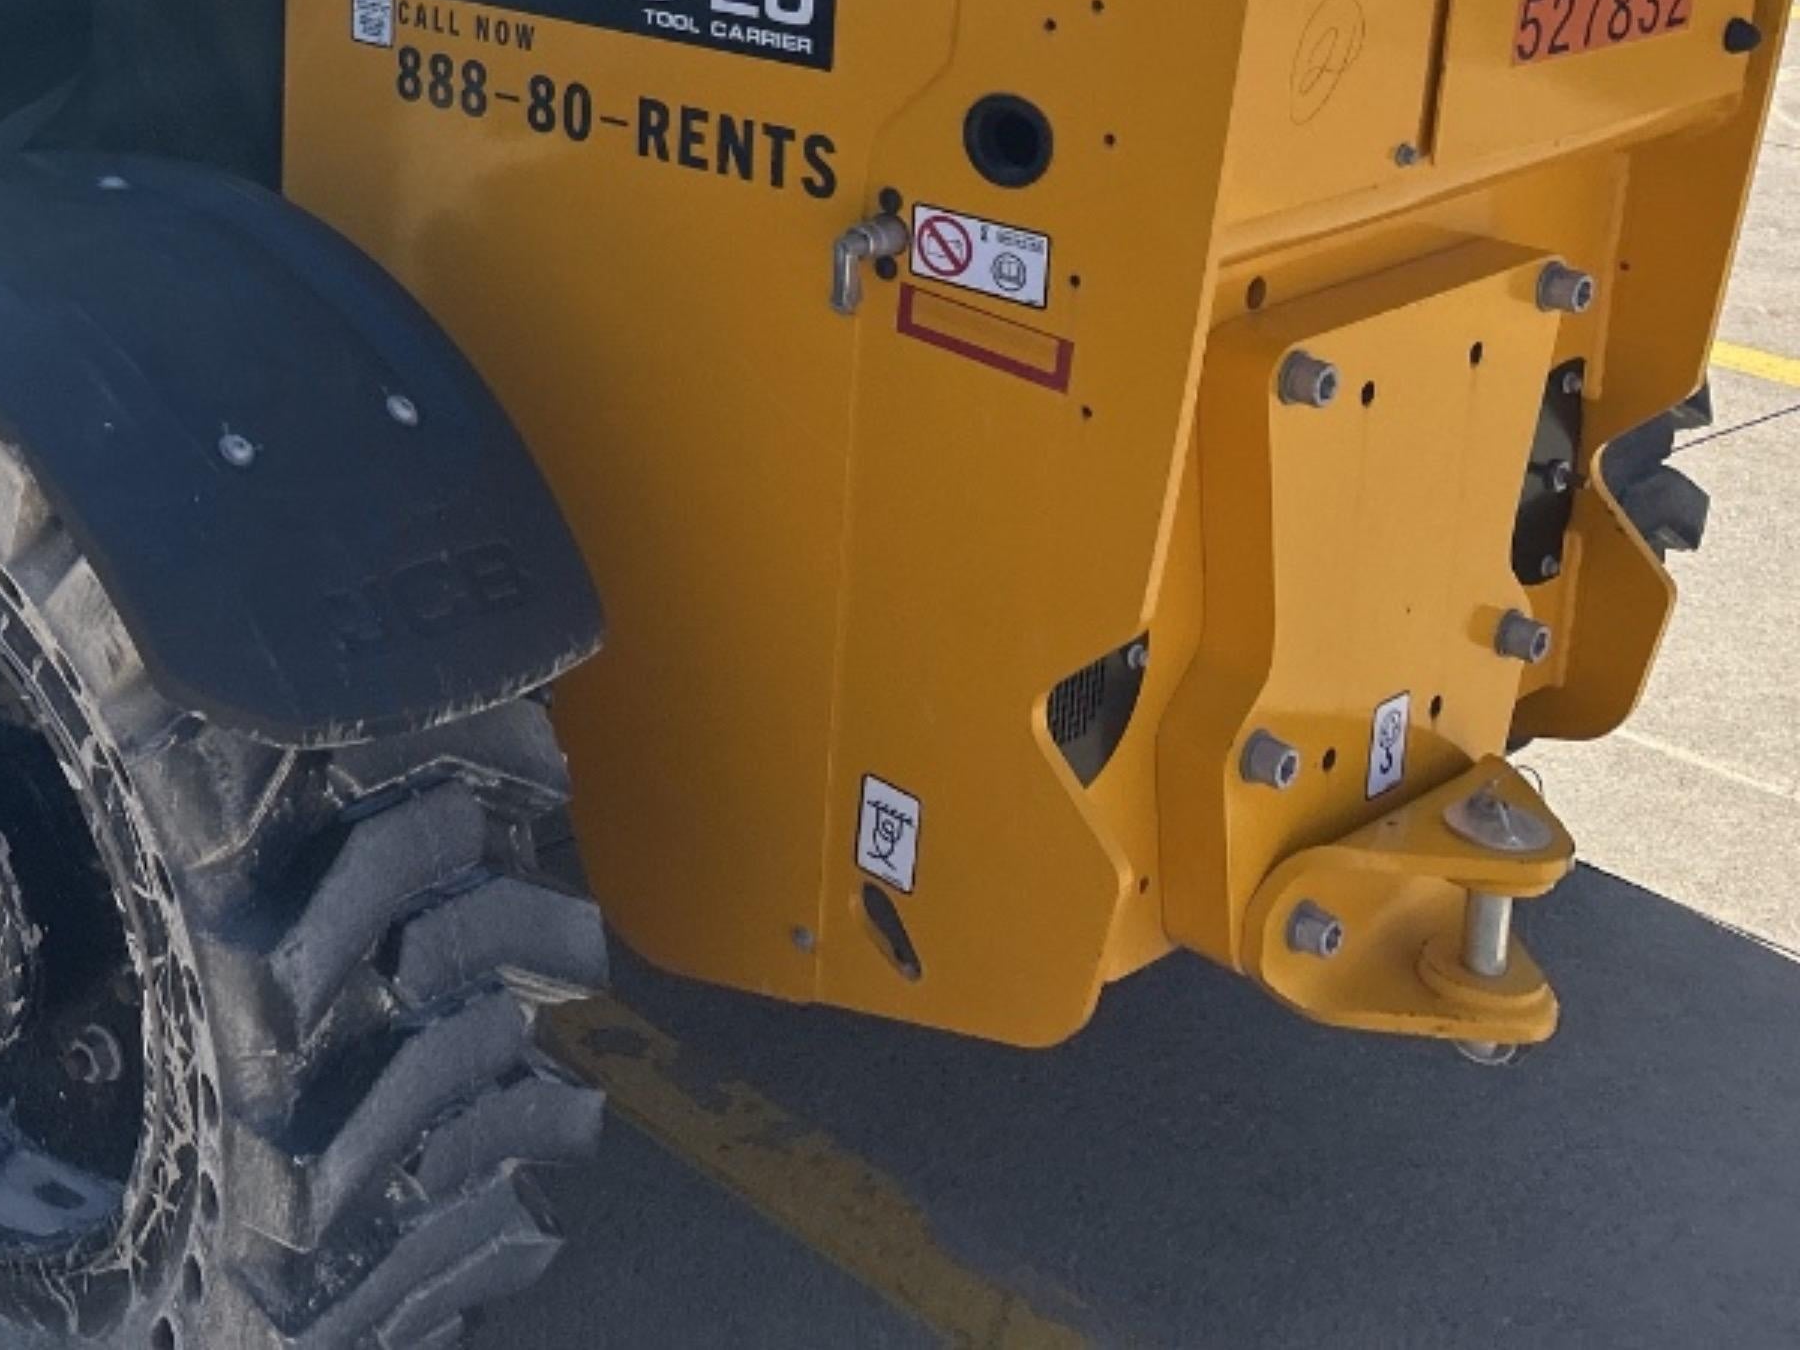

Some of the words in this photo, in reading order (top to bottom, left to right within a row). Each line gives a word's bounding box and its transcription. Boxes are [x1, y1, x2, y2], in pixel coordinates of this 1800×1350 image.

[397, 0, 461, 37] CALL
[475, 14, 536, 52] NOW
[642, 8, 701, 35] TOOL
[709, 20, 813, 55] CARRIER
[395, 46, 837, 199] 888-80-RENTS
